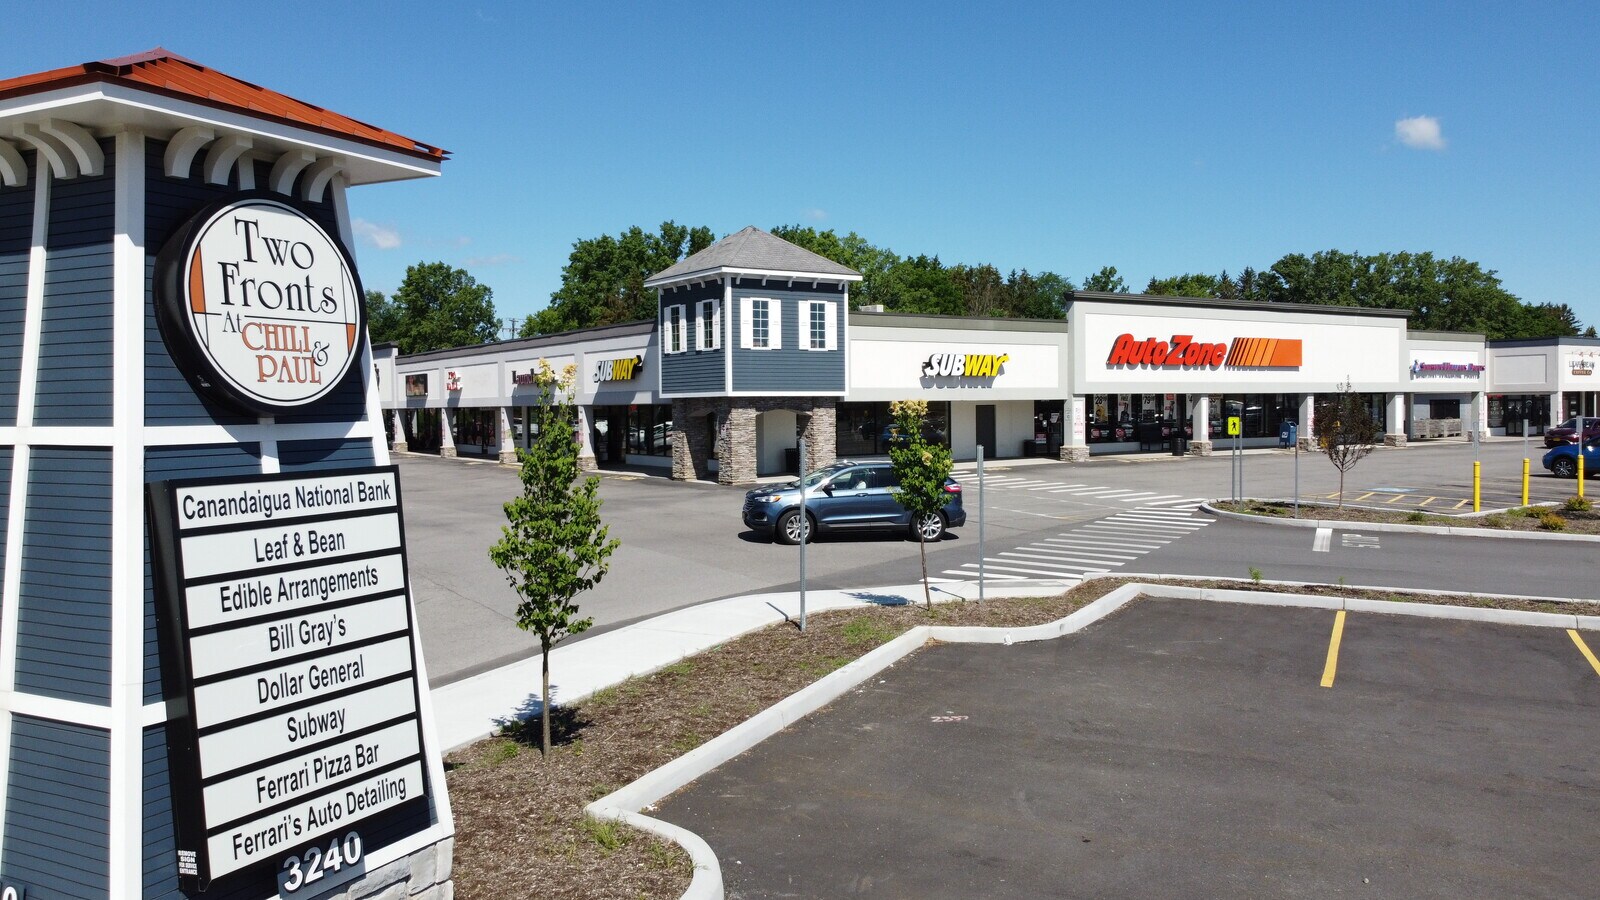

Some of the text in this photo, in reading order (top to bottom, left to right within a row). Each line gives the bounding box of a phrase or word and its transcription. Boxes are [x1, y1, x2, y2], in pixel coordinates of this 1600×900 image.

[234, 216, 315, 270] Two
[218, 261, 338, 314] Fronts
[222, 311, 242, 334] At
[242, 322, 330, 367] CHILI &
[1107, 333, 1227, 366] AutoZone
[256, 355, 322, 385] PAUL
[592, 356, 640, 382] SUBWAY
[923, 353, 1009, 376] SUBWAY
[183, 480, 391, 519] Canandaigua National Bank
[254, 530, 345, 563] Leaf & Bean
[220, 564, 379, 612] Edible Arrangements
[269, 614, 346, 652] Bill Gray's
[257, 654, 364, 704] Dollar General
[287, 708, 346, 742] Subway
[256, 743, 379, 803] Ferrari Pizza Bar
[232, 776, 406, 860] Ferrari's Auto Detailing
[284, 831, 363, 892] 3240
